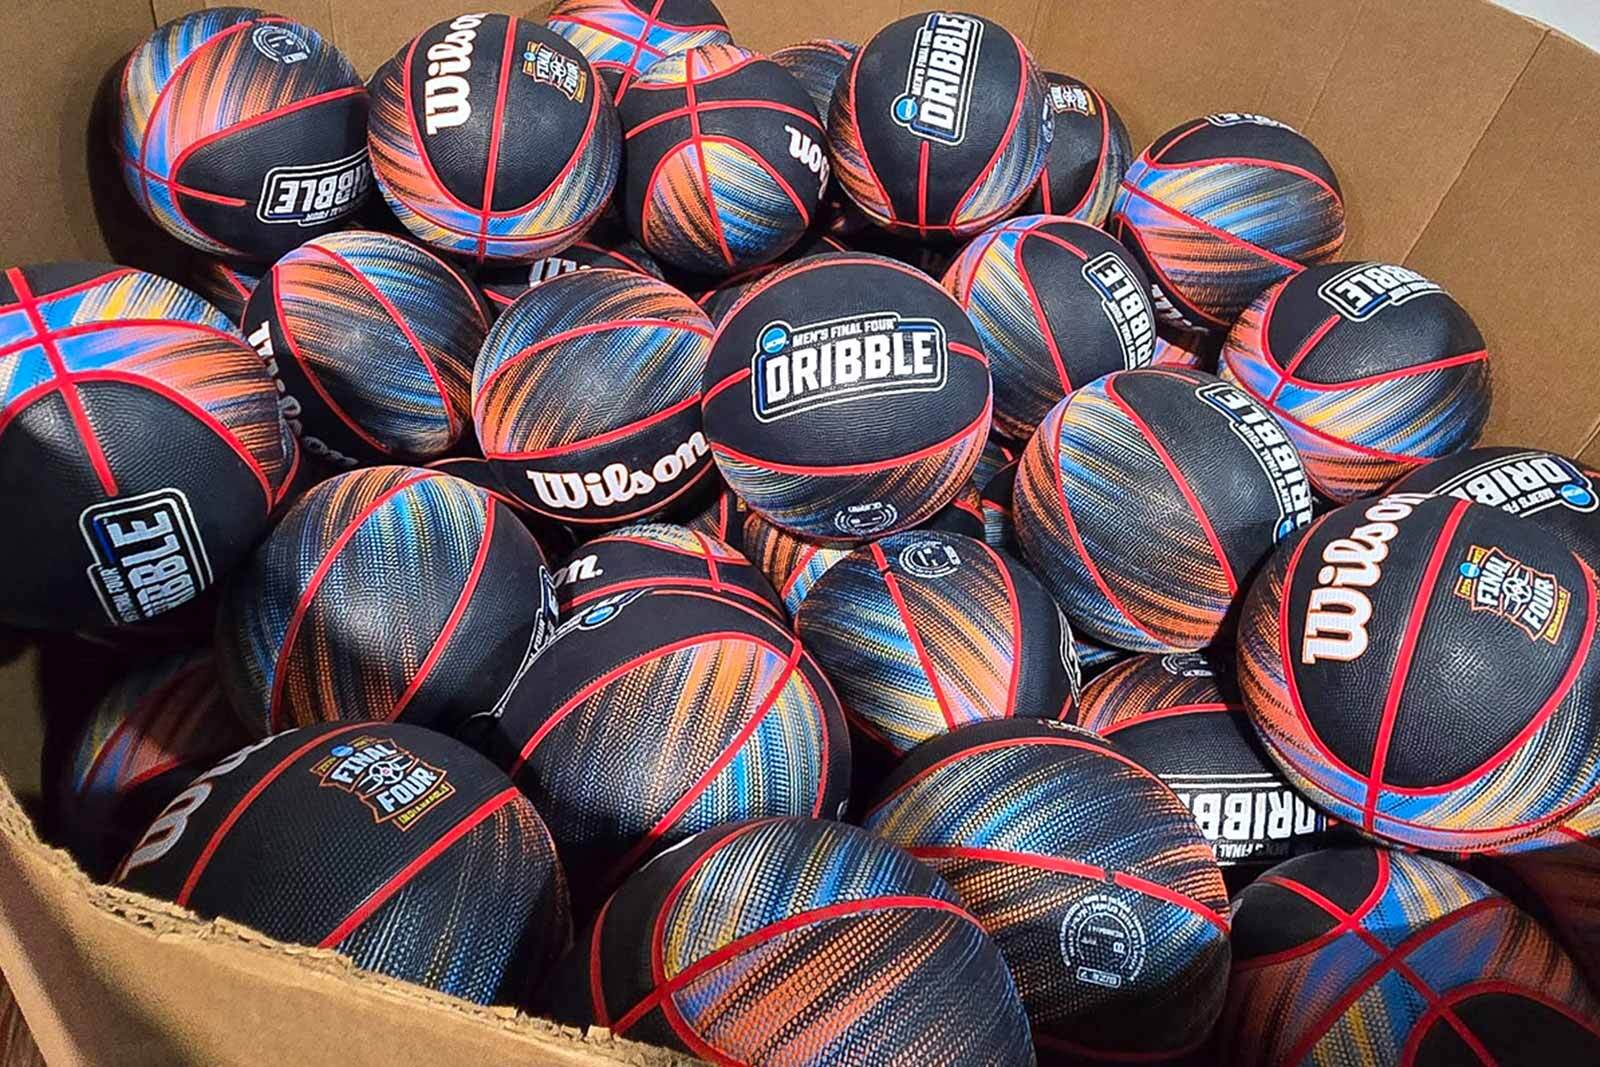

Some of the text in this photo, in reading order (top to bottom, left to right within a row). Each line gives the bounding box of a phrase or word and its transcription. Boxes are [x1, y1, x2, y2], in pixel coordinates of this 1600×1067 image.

[920, 15, 972, 130] DRIBBLE
[792, 328, 828, 347] MEN'S
[831, 322, 863, 339] FINAL
[864, 318, 897, 332] FOUR
[766, 331, 937, 404] DRIBBLE
[1238, 423, 1264, 450] FOUR
[526, 431, 711, 510] Wilson
[1259, 450, 1282, 478] FINAL
[1477, 556, 1513, 606] FINAL
[1522, 577, 1554, 630] FOUR
[330, 743, 397, 784] FINAL
[376, 766, 438, 813] FOUR
